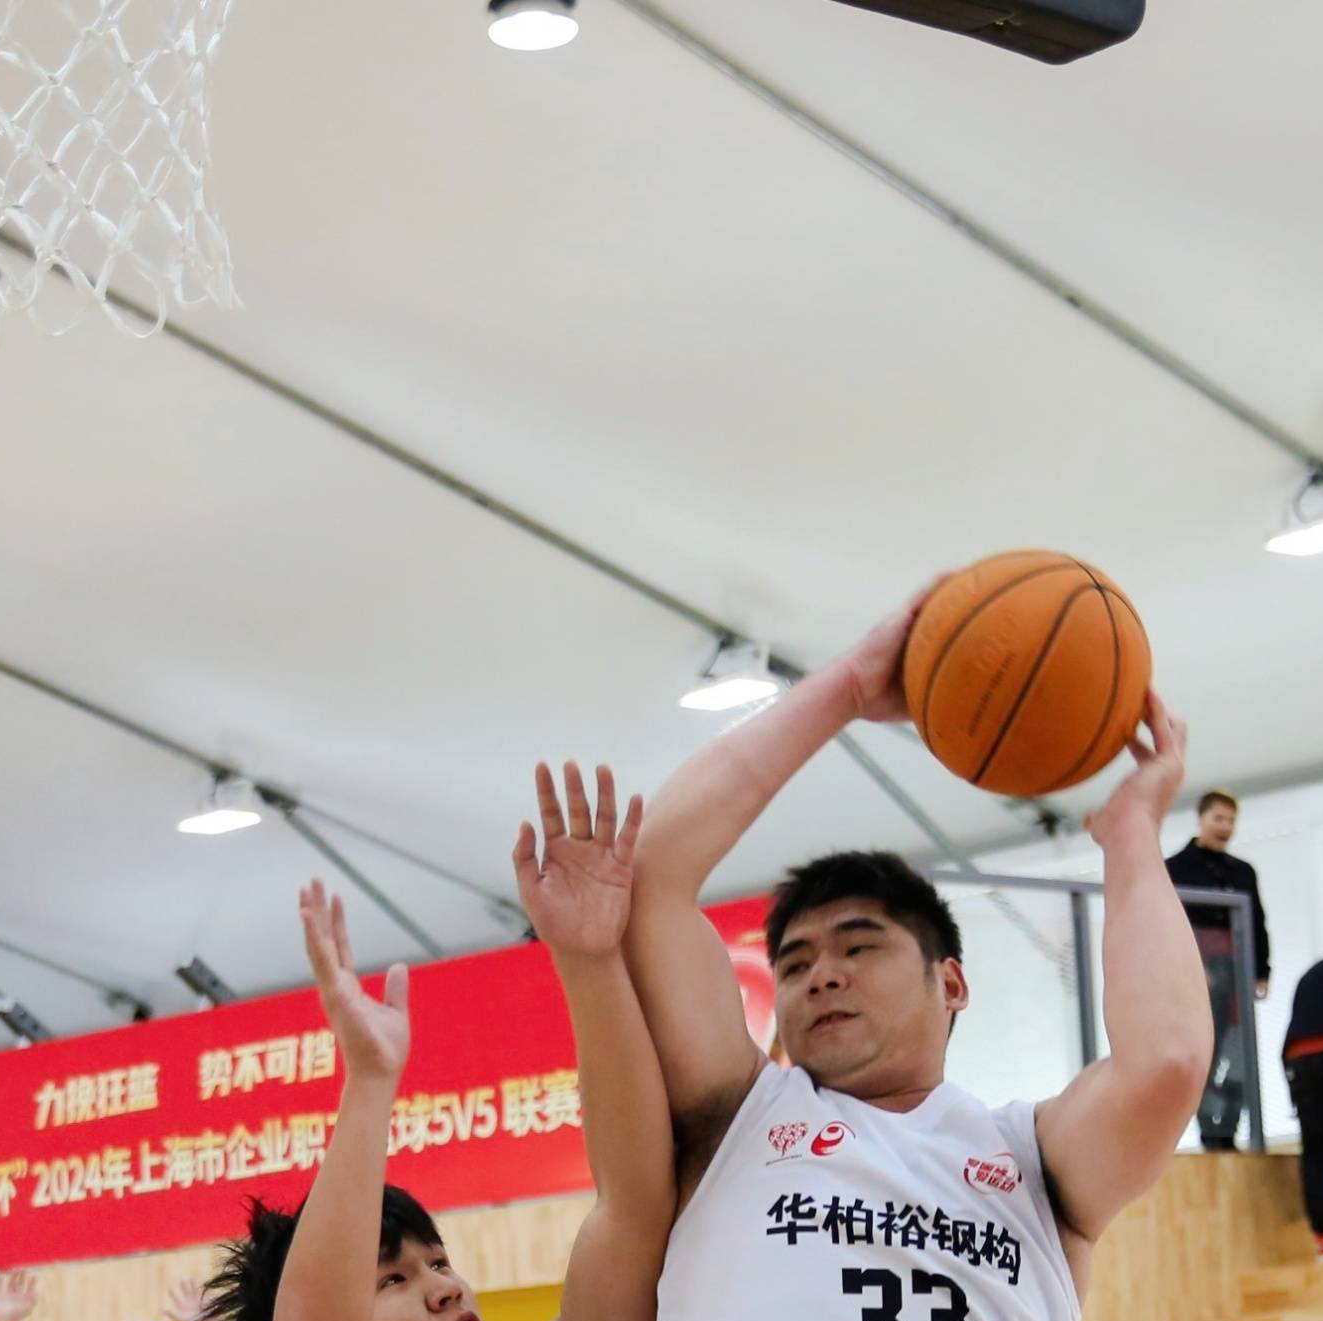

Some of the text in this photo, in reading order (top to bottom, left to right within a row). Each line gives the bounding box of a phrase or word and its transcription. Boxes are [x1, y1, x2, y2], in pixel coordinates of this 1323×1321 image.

[197, 1028, 337, 1101] 势不可挡
[765, 1192, 1022, 1286] 华柏裕钢构
